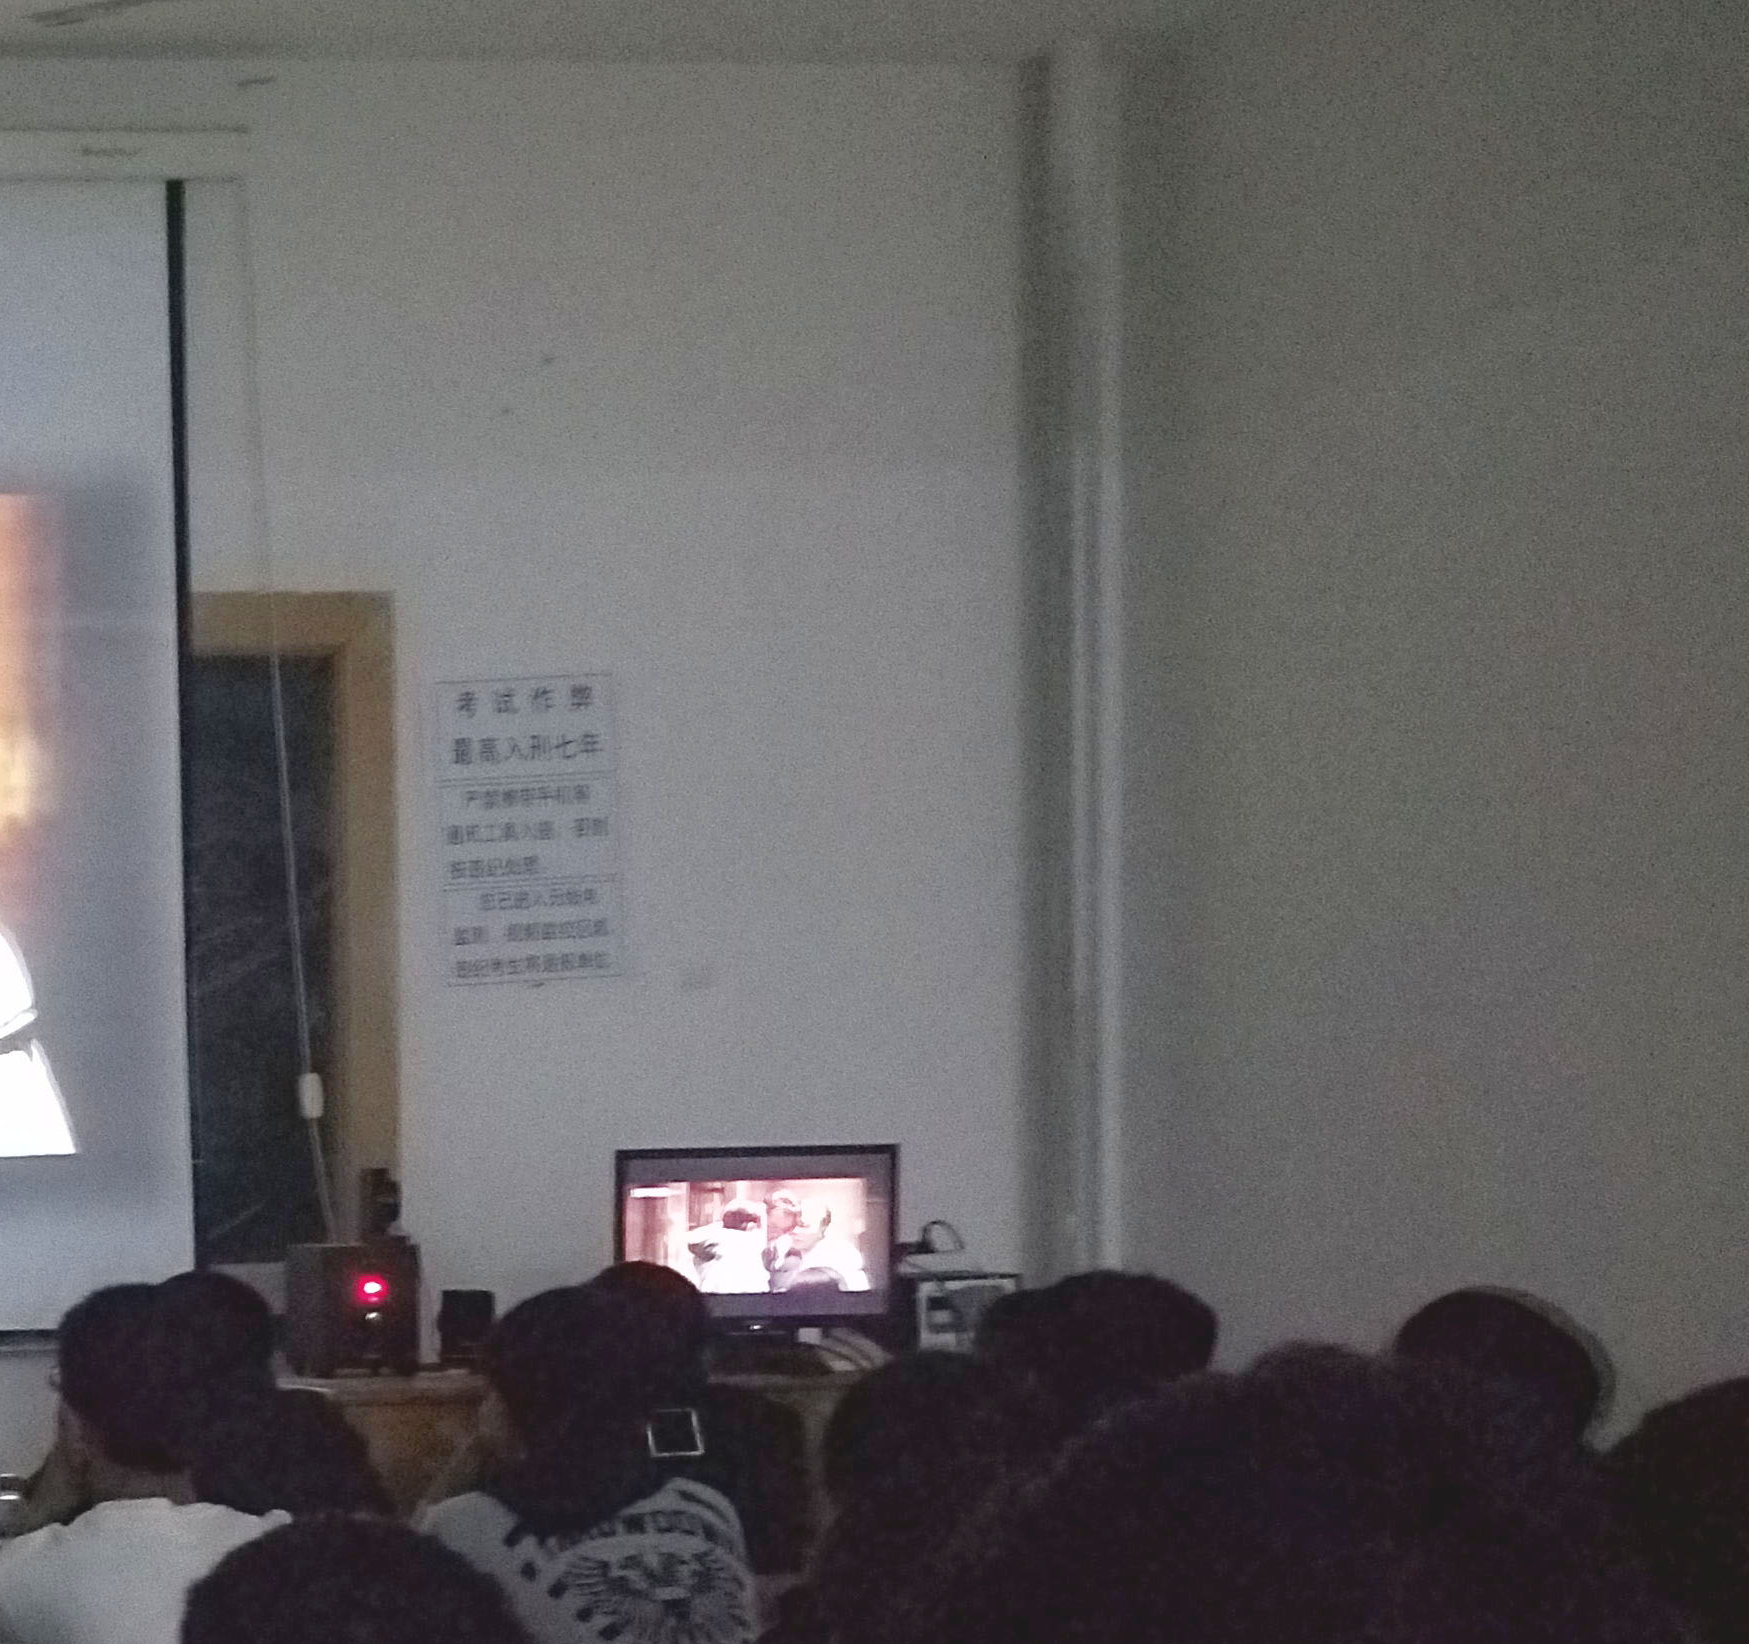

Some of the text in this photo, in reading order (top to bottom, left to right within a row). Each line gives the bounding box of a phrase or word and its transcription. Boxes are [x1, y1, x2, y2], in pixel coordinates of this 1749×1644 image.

[453, 733, 603, 765] 最高入刑七年
